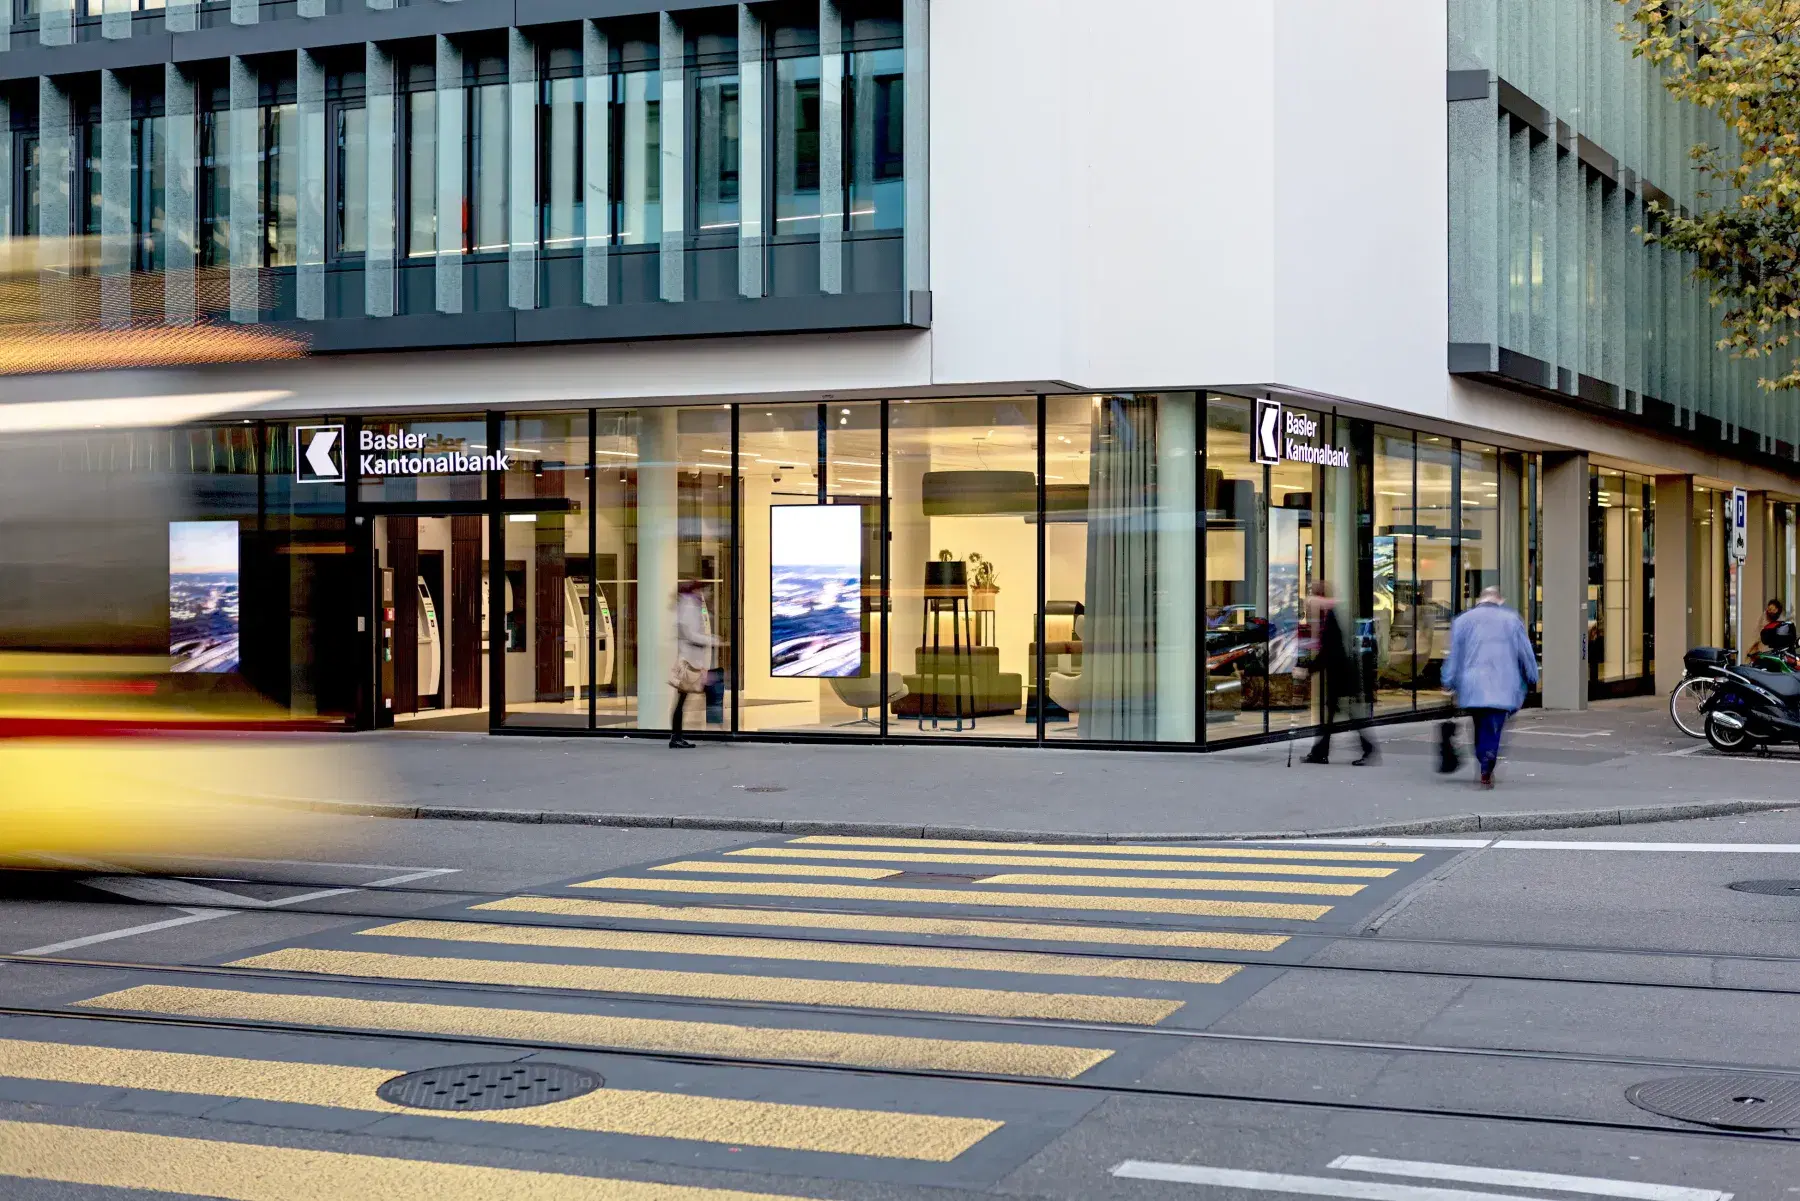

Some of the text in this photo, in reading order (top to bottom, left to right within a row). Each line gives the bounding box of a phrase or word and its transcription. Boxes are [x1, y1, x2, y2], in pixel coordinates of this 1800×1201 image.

[1286, 411, 1317, 437] Basler
[360, 429, 427, 450] Basler
[360, 450, 509, 474] Kantonalbank
[1286, 438, 1349, 468] Kantonalbank
[1738, 500, 1743, 524] P
